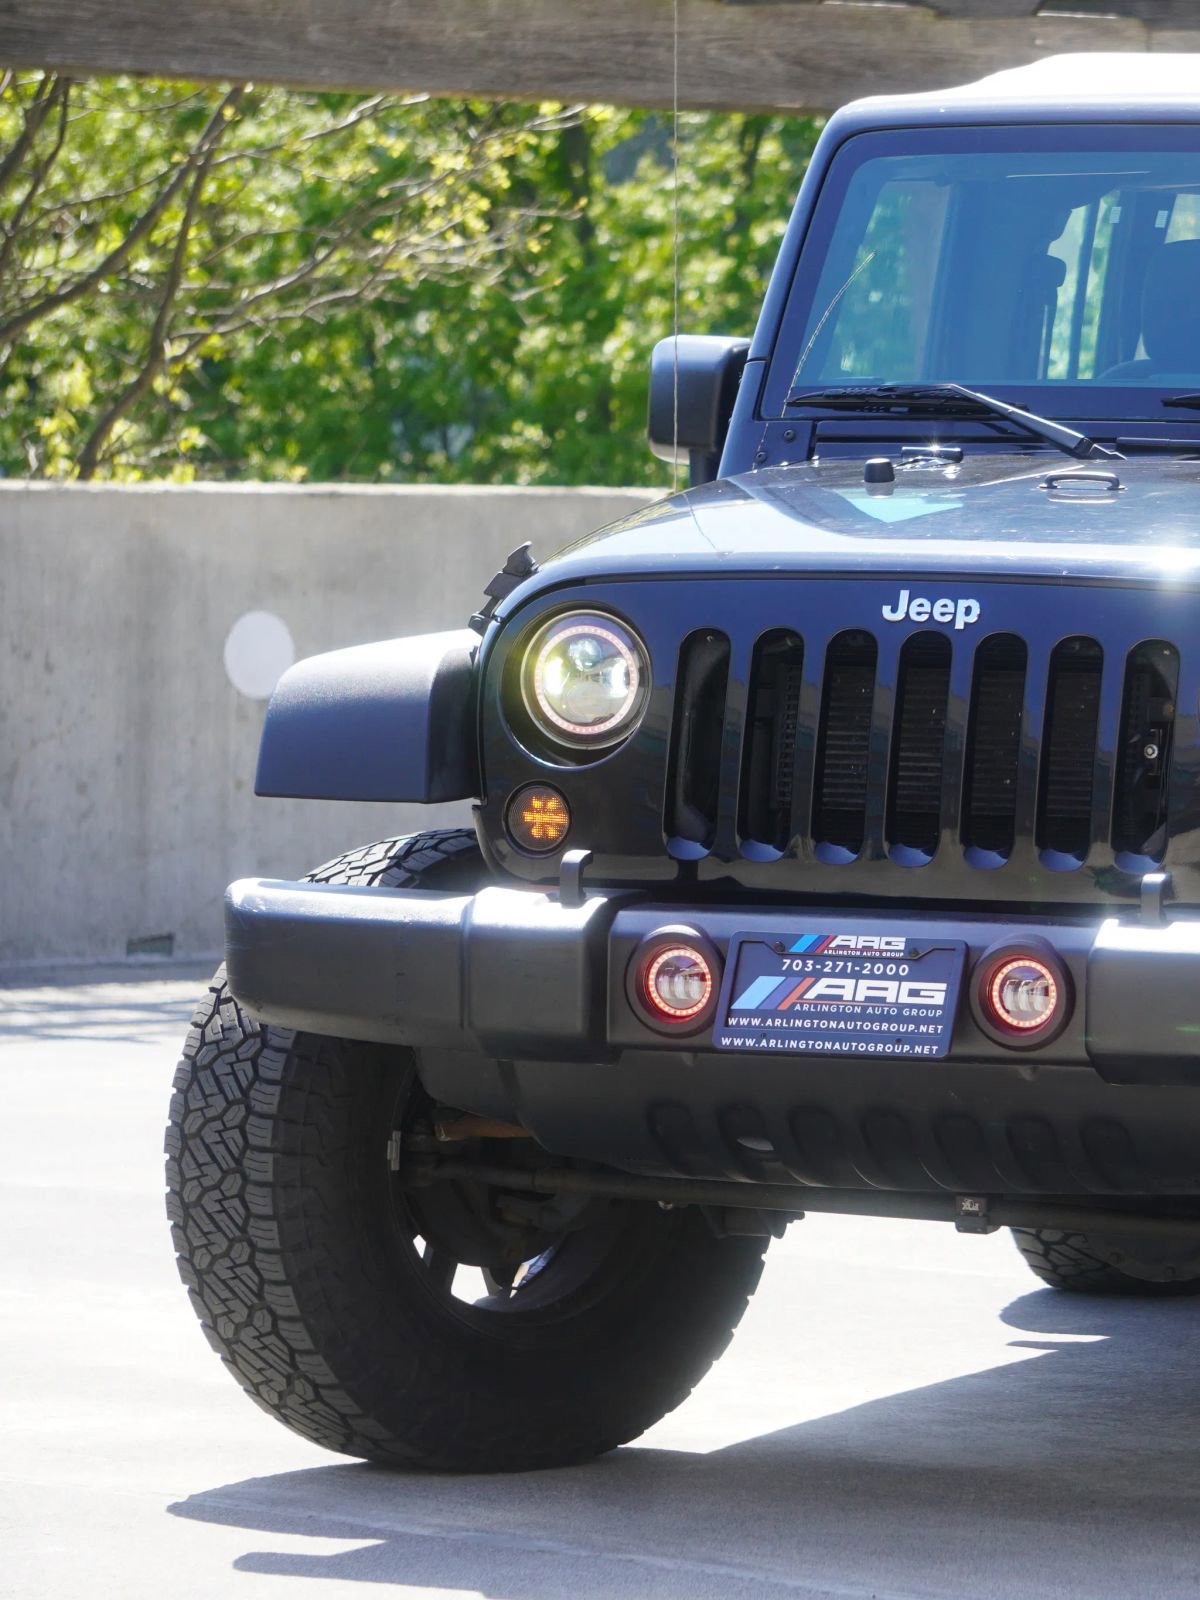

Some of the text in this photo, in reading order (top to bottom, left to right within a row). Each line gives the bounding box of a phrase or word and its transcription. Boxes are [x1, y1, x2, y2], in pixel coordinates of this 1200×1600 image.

[882, 589, 981, 630] Jeep
[829, 934, 906, 950] AAG
[823, 949, 861, 957] ARLINGTON
[781, 959, 909, 976] 703-271-2000
[803, 977, 948, 1006] AAG
[794, 1003, 943, 1018] ARLINGTON AUTO GROUP
[728, 1017, 944, 1034] WWW.ARLINGTONAUTOGROUP.NET
[721, 1037, 939, 1054] WWW.ARLINGTONAUTOGROUP.NET
